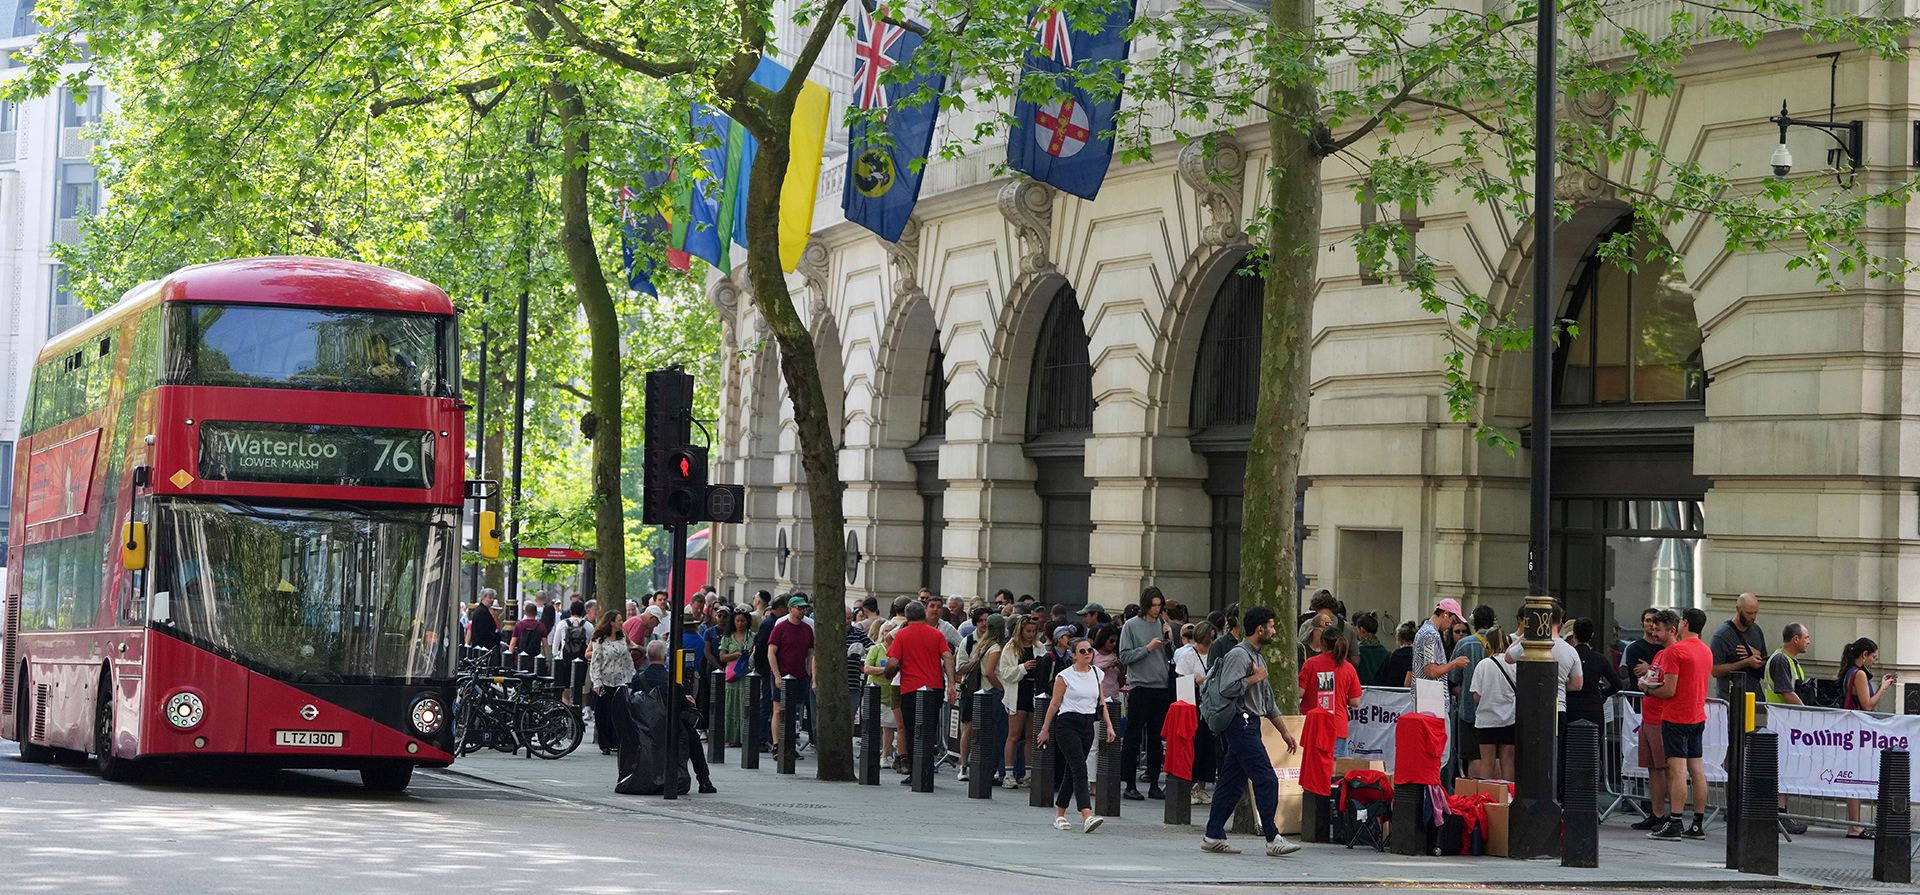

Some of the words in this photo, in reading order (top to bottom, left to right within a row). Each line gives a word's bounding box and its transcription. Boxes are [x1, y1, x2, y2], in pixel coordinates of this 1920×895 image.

[224, 433, 337, 457] Waterloo
[240, 456, 277, 468] LOWER
[281, 458, 319, 469] MARSH
[373, 439, 413, 472] 76
[283, 732, 306, 744] LTZ
[309, 733, 335, 745] 1300
[1790, 728, 1854, 751] Polling
[1859, 730, 1909, 749] Place
[1836, 770, 1853, 779] AEC
